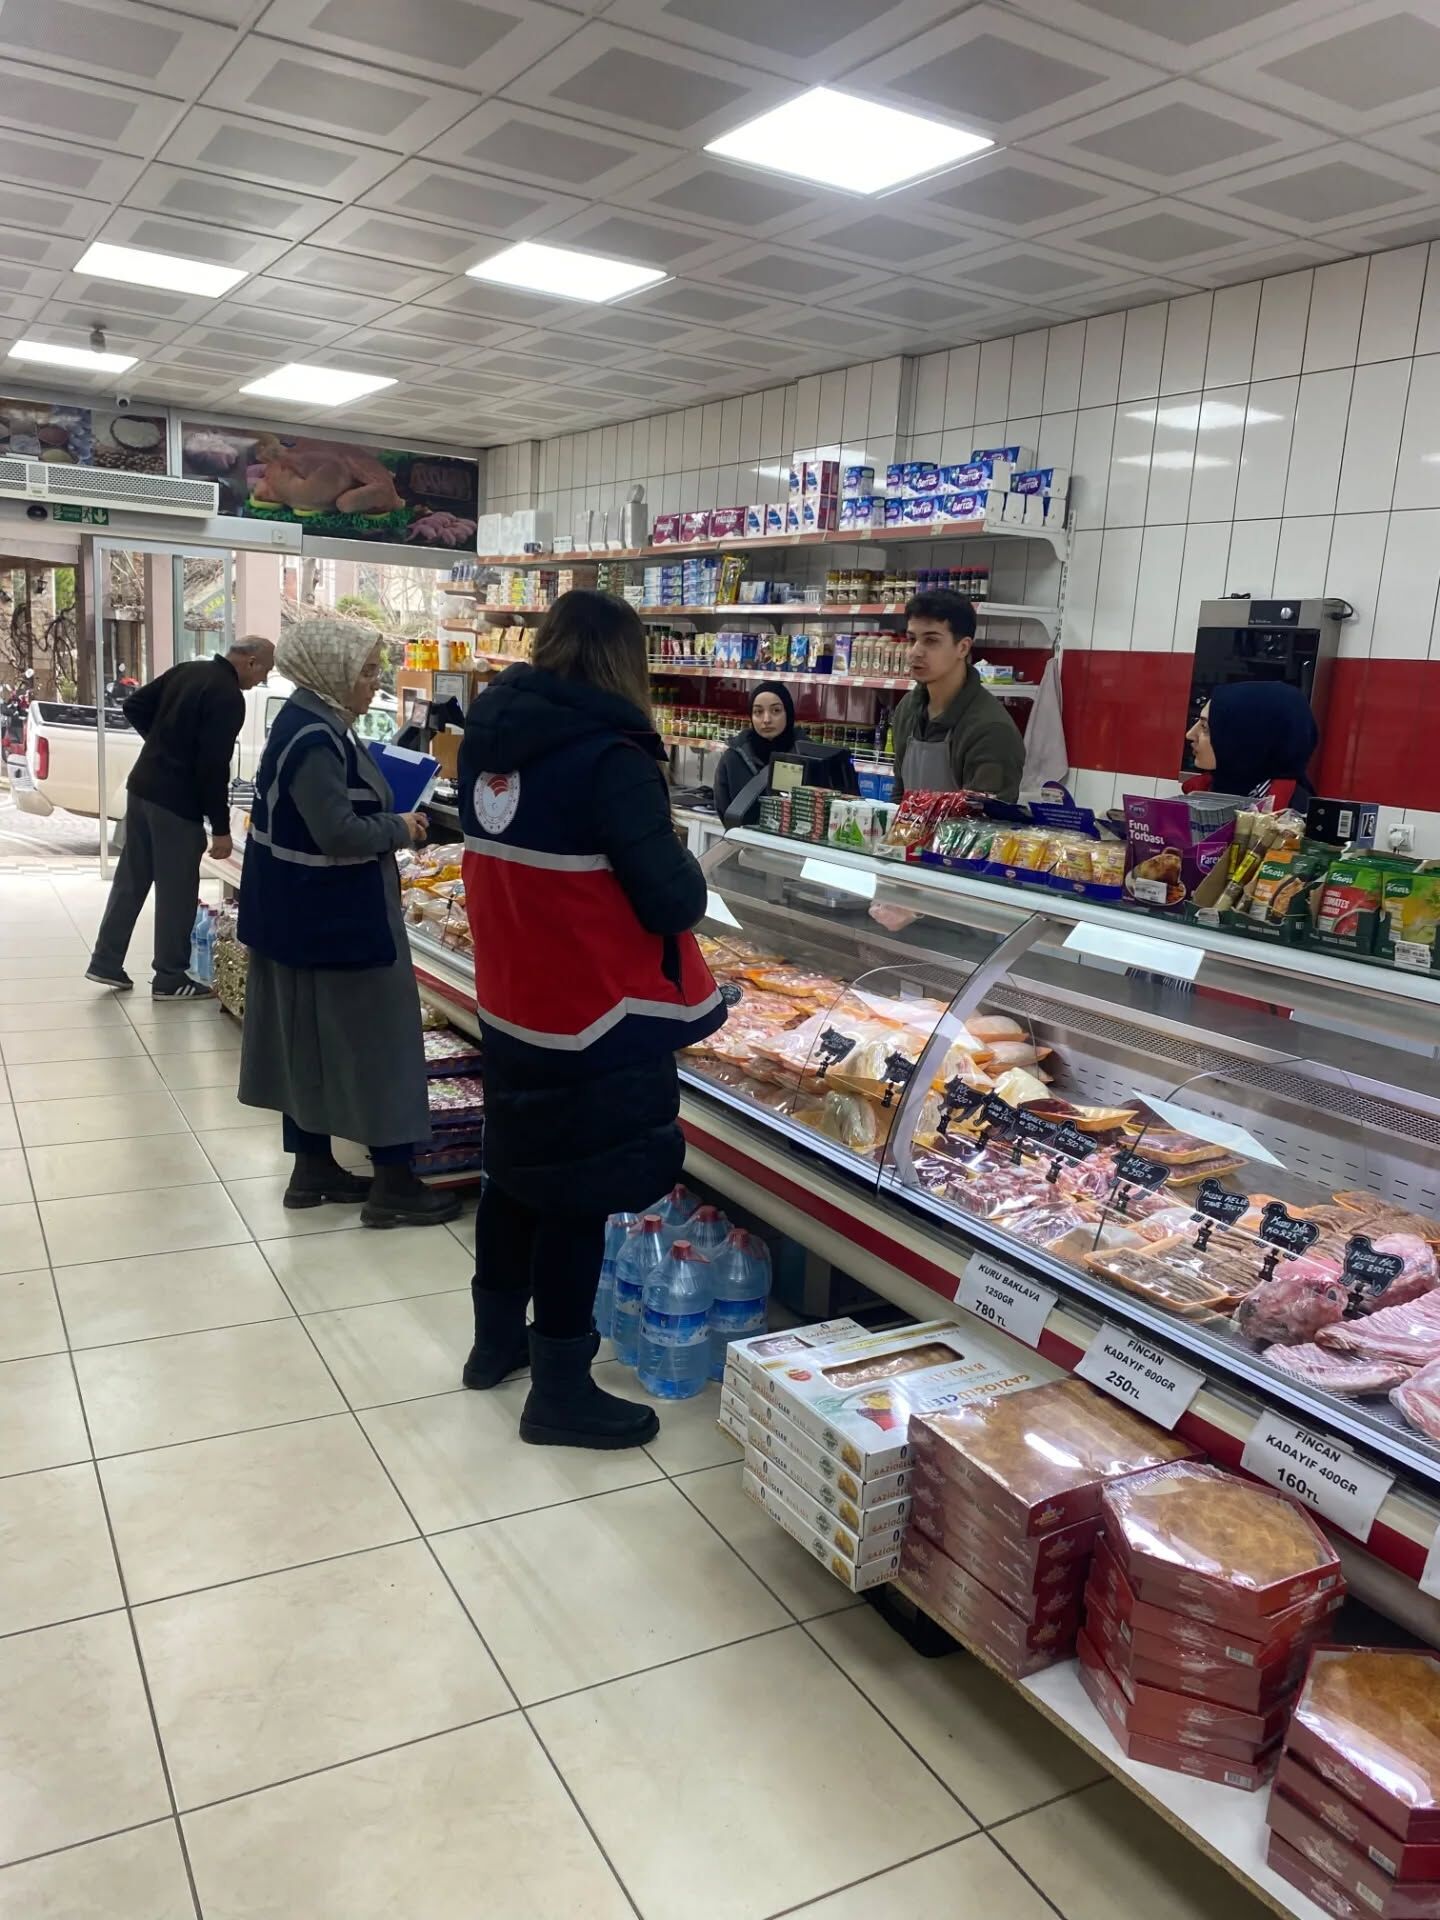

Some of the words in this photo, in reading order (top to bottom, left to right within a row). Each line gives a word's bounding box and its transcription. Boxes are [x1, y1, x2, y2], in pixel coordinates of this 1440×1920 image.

[1262, 863, 1285, 878] Knorr
[1331, 872, 1354, 885] Knorr
[1386, 880, 1411, 895] Knorr
[978, 1262, 1003, 1281] KURU
[1001, 1276, 1041, 1303] BAKLAVA
[984, 1284, 1015, 1307] 1250GR
[974, 1299, 996, 1321] 780
[996, 1315, 1007, 1328] TL
[1103, 1343, 1145, 1374] KADAYIF
[1144, 1367, 1177, 1393] 800GR
[1265, 1433, 1318, 1471] KADAYIF
[1318, 1466, 1359, 1496] 400GR
